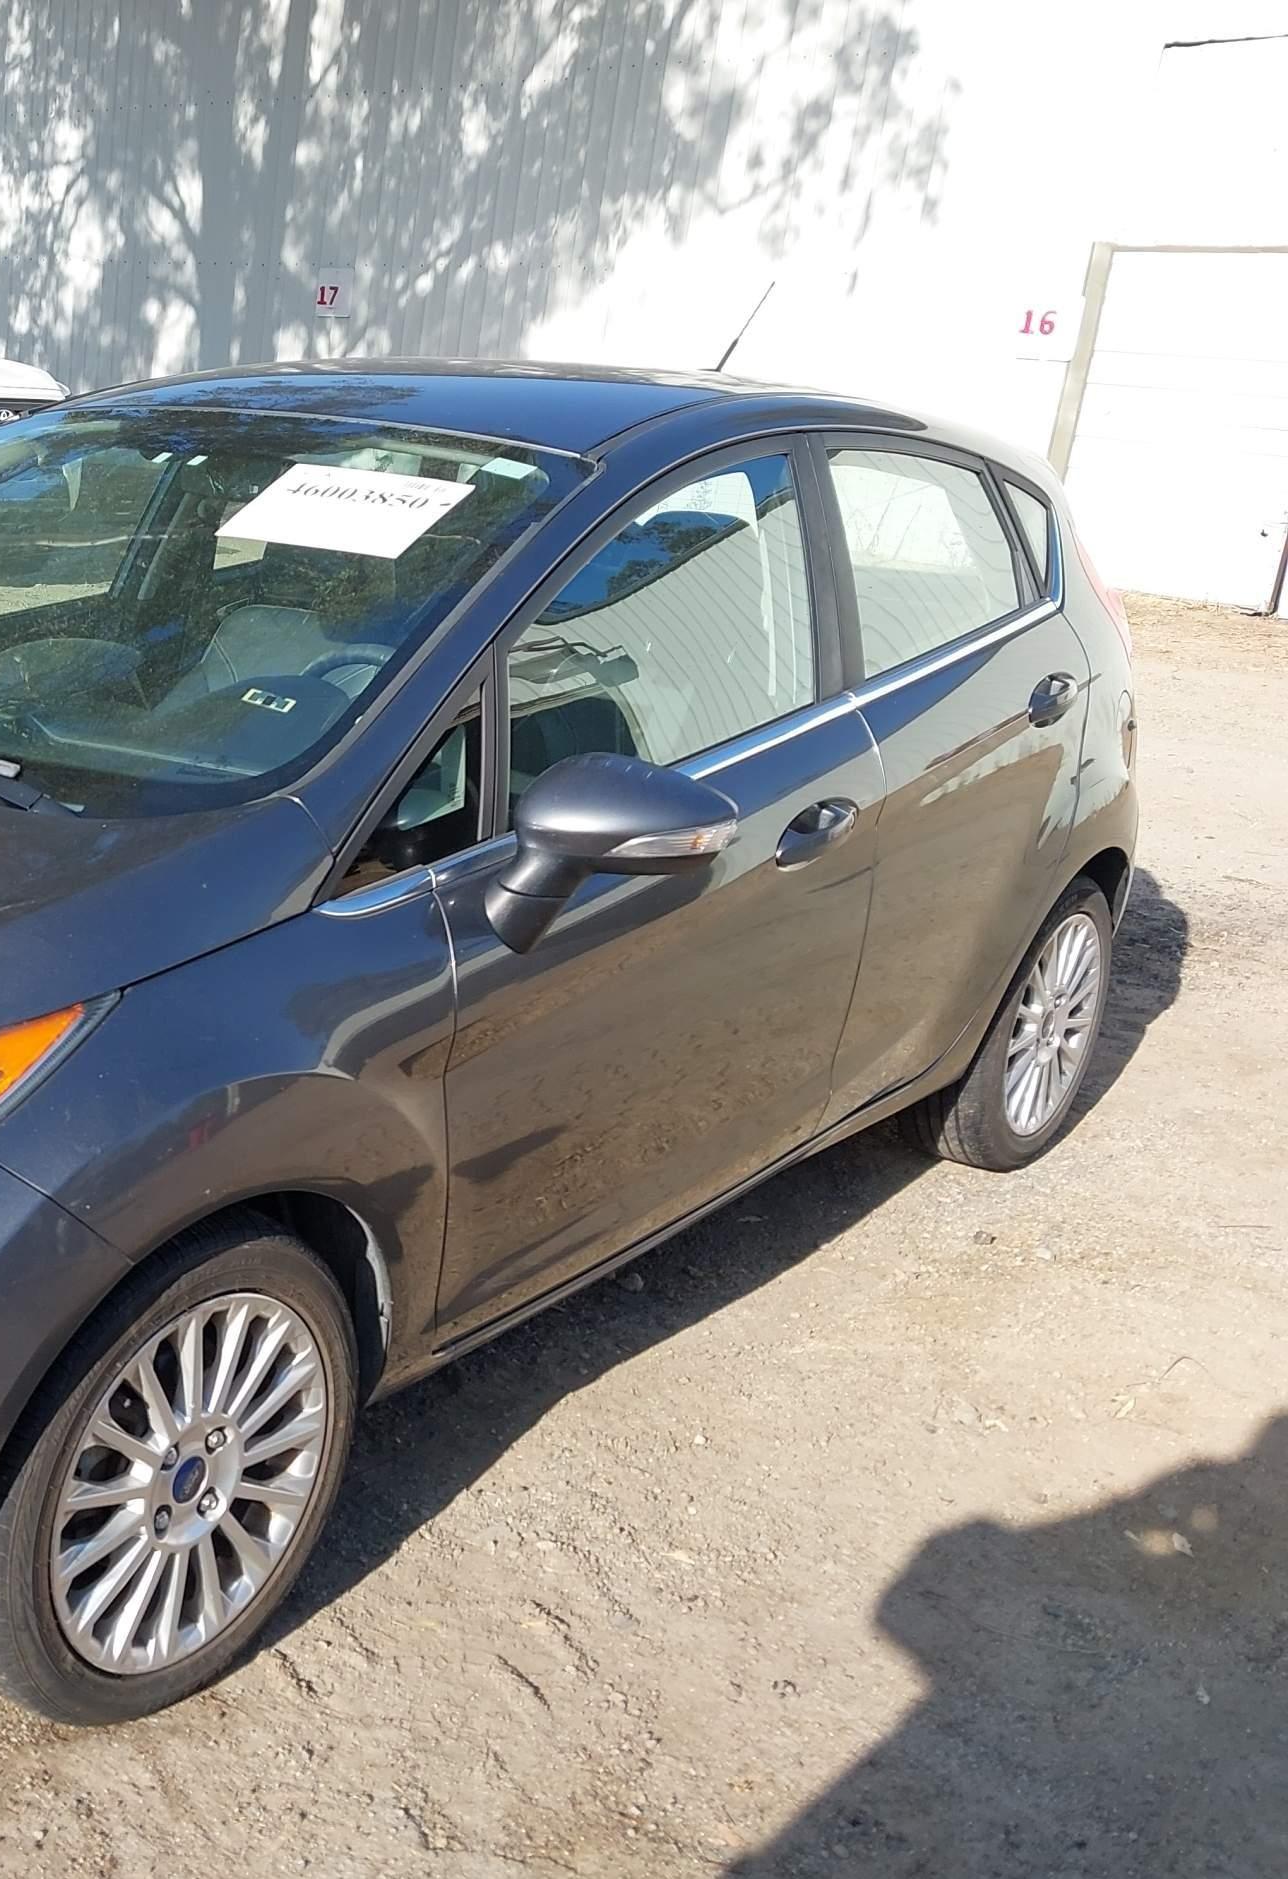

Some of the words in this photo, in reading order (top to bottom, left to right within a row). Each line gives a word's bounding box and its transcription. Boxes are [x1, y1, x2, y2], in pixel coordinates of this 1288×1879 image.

[317, 285, 339, 305] 17
[1019, 309, 1057, 336] 16
[287, 481, 429, 509] 46003850
